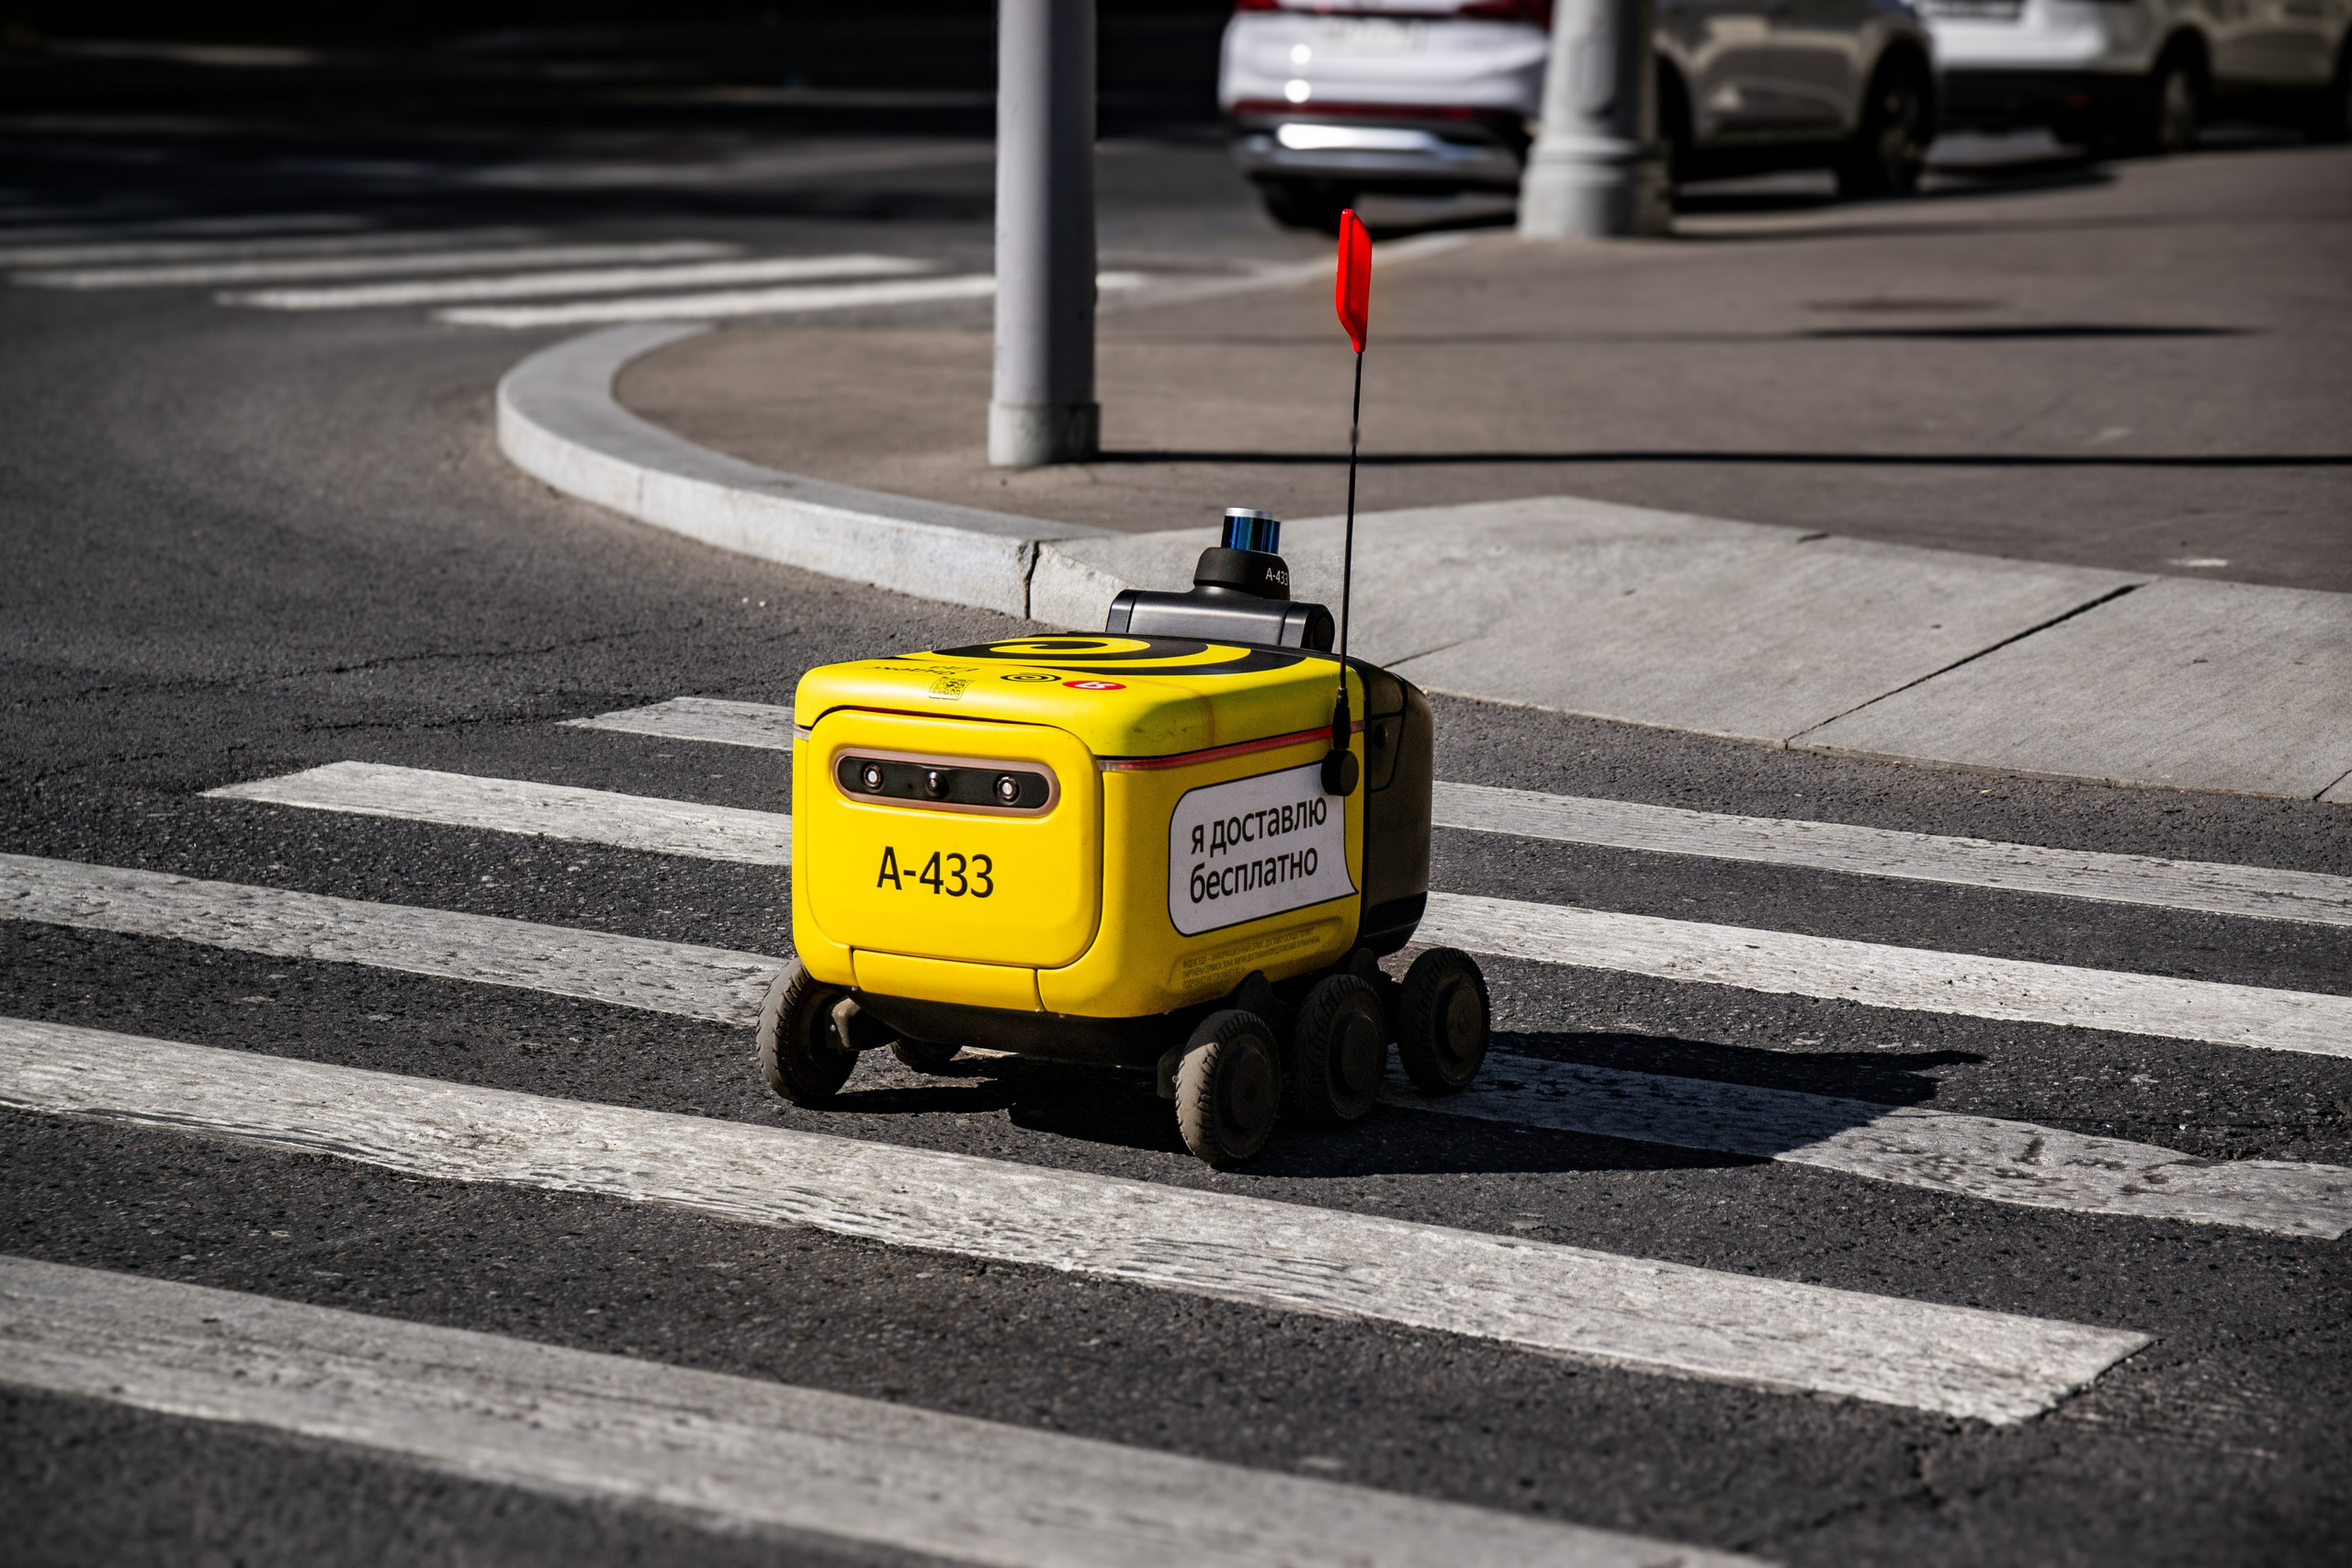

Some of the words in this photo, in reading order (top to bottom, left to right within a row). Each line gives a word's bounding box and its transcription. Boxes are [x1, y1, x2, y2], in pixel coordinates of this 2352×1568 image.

[1191, 824, 1204, 855] я
[1209, 796, 1328, 858] доставлю
[876, 846, 994, 898] A-433
[1190, 847, 1318, 904] бесплатно
